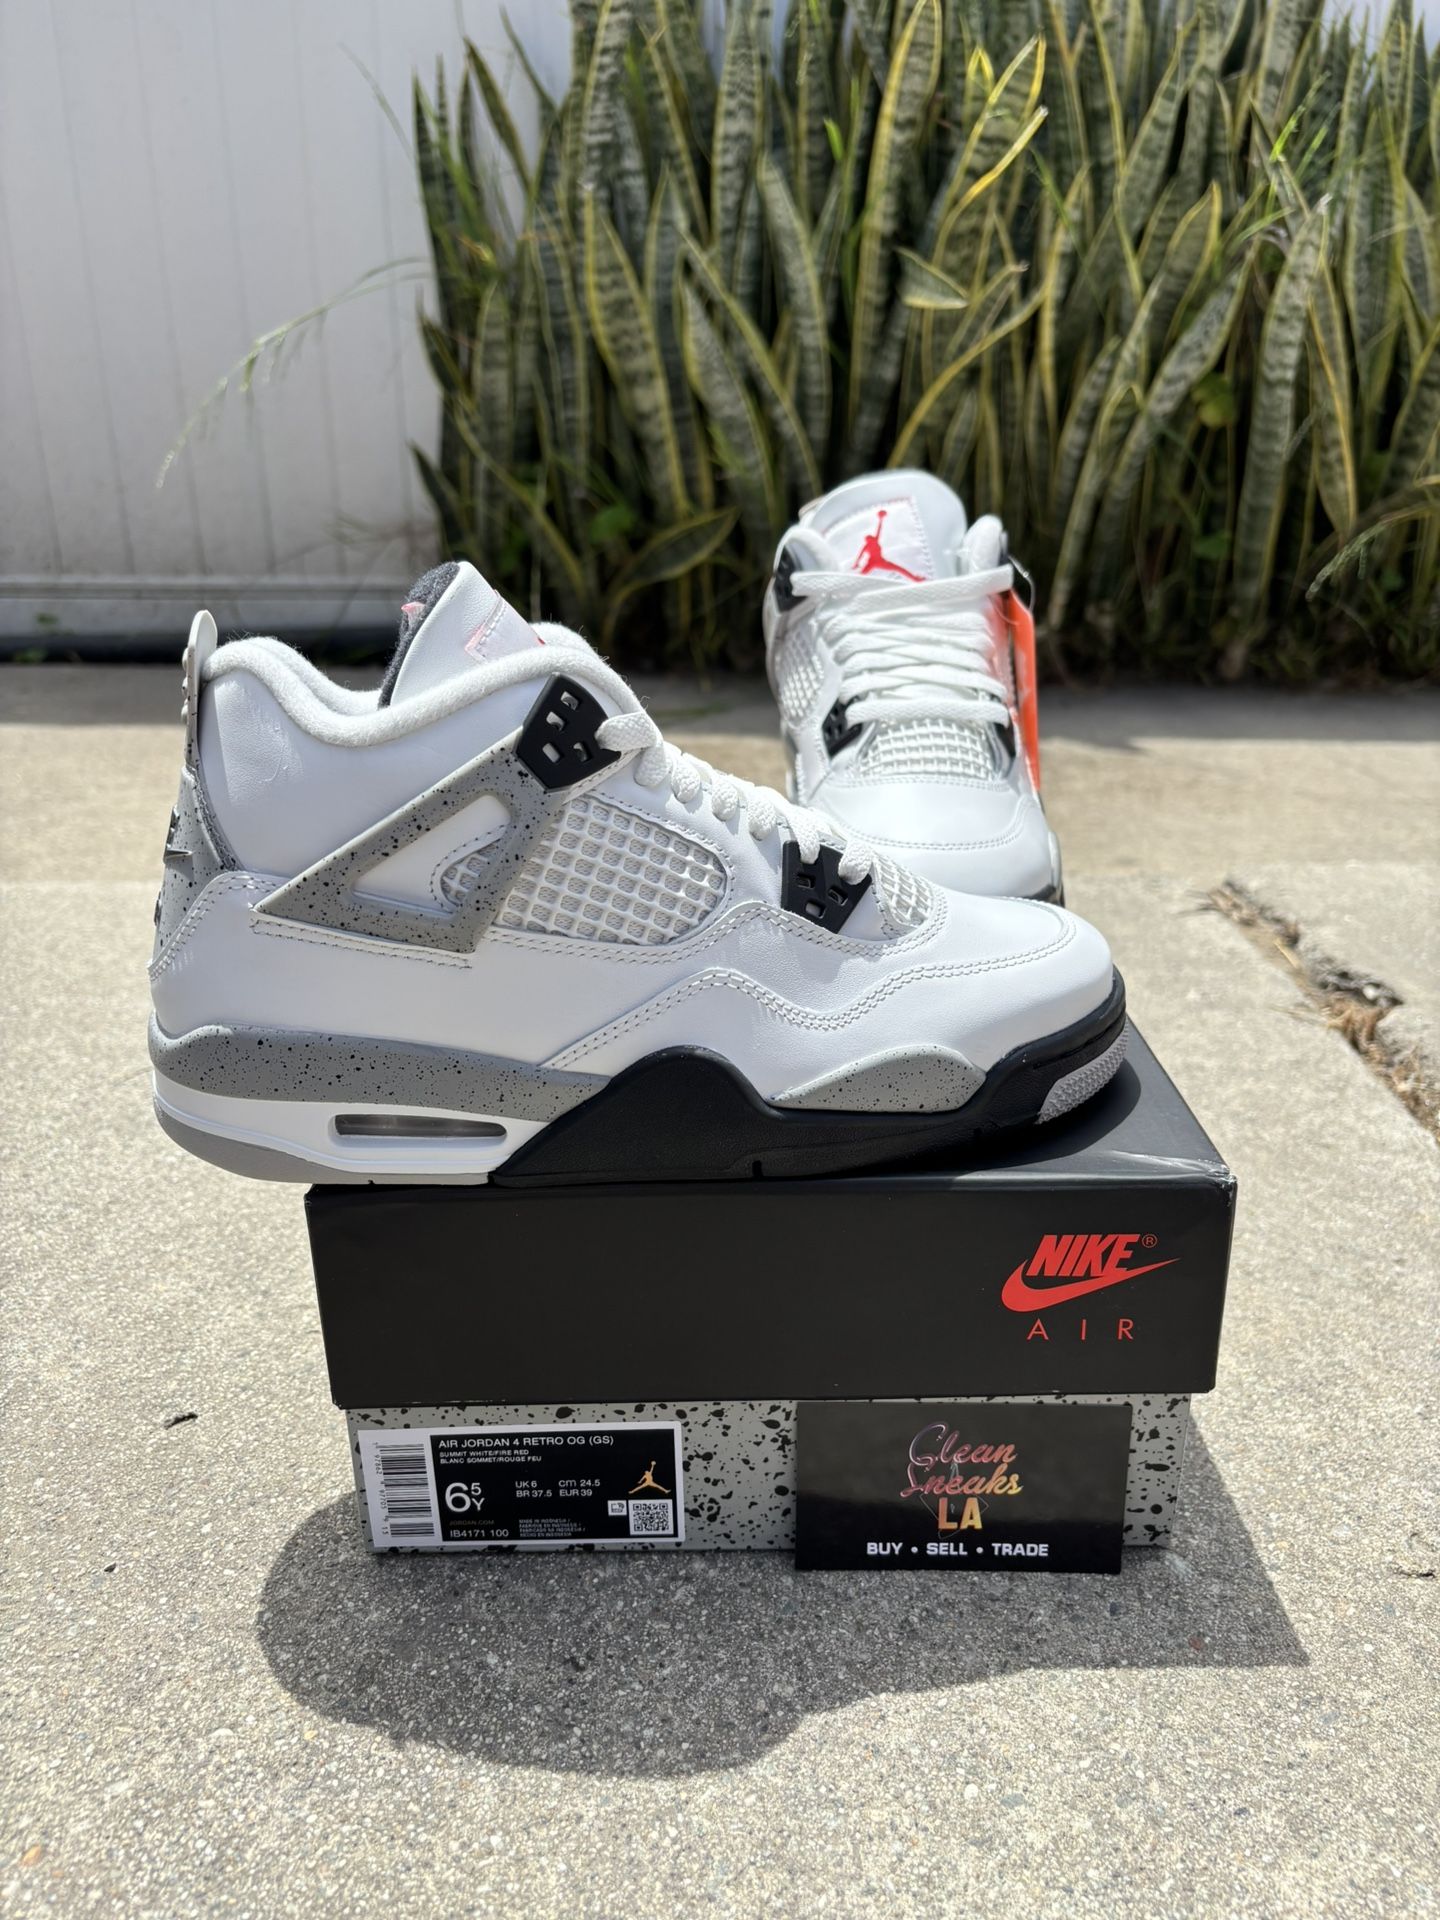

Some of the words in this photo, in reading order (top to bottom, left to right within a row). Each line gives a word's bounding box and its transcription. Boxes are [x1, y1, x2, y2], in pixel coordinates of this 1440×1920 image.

[1026, 1233, 1141, 1277] NIKE
[1026, 1318, 1134, 1340] AIR
[438, 1439, 458, 1448] AIR
[461, 1438, 510, 1448] JORDAN
[513, 1438, 520, 1446] 4
[523, 1436, 564, 1446] RETRO
[567, 1436, 586, 1445] OG
[589, 1435, 614, 1446] (GS)
[909, 1421, 1018, 1466] Clean
[580, 1479, 601, 1487] 24.5
[900, 1454, 1024, 1498] Sneaks
[515, 1480, 530, 1488] UK
[531, 1480, 538, 1488] 6
[532, 1489, 552, 1497] 37.5
[559, 1489, 579, 1497] EUR
[938, 1497, 983, 1530] LA
[450, 1529, 486, 1537] IB4171
[490, 1529, 509, 1537] 100
[866, 1542, 903, 1555] BUY
[926, 1542, 968, 1556] SELL
[991, 1543, 1049, 1557] TRADE
